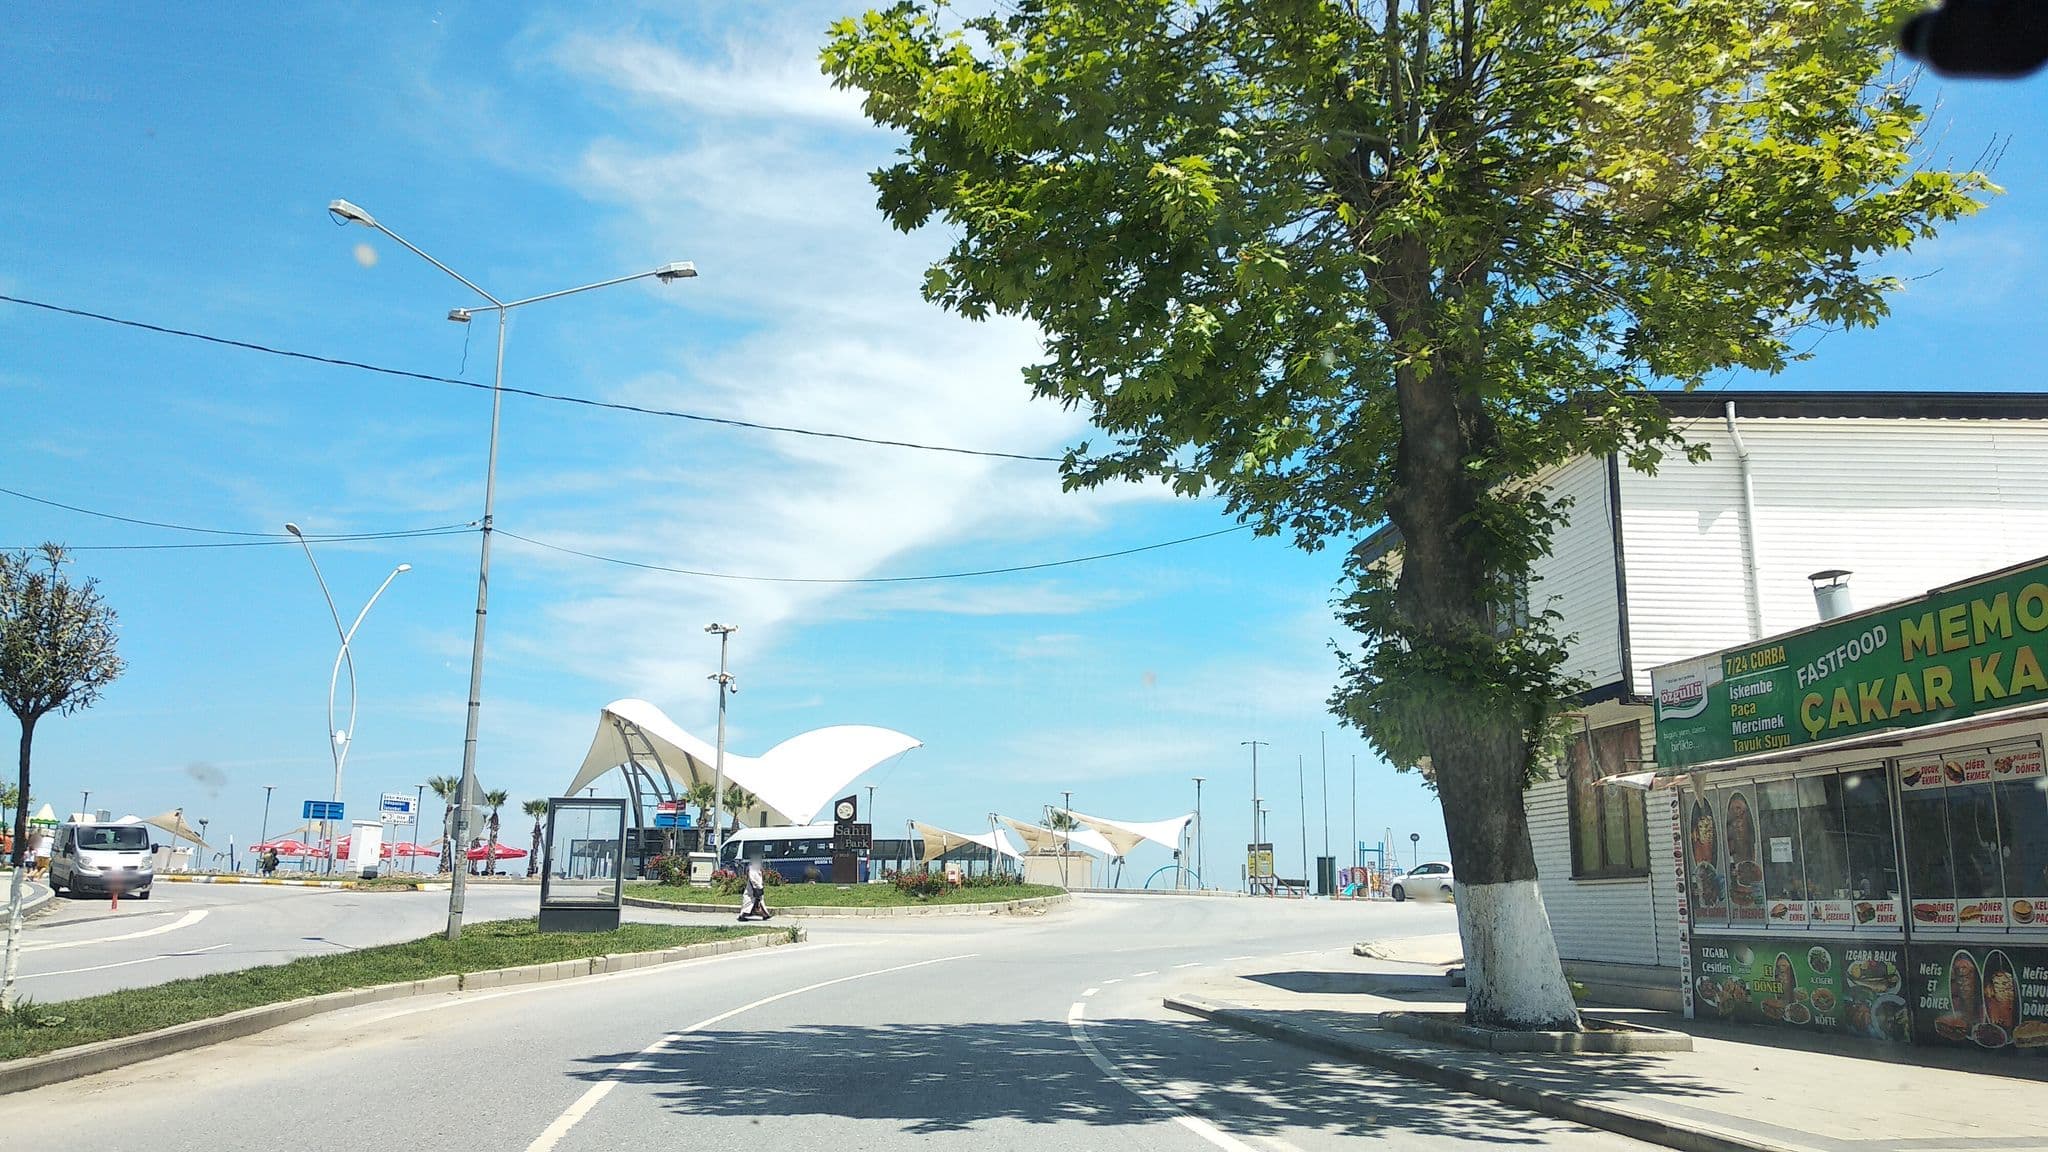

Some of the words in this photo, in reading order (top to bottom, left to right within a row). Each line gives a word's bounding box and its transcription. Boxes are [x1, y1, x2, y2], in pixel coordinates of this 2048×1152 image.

[1726, 656, 1748, 675] 7/24
[1750, 645, 1787, 670] ÇORBA
[1796, 625, 1888, 690] FASTFOOD
[1661, 681, 1703, 706] özgüllü
[1729, 680, 1773, 700] İşkembe
[1731, 702, 1756, 717] Paça
[1801, 666, 1956, 740] ÇAKAR
[1732, 714, 1784, 735] Mercimek
[1733, 736, 1762, 753] Tavuk
[1765, 734, 1790, 749] Suyu
[1922, 775, 1942, 786] EKMEK
[1966, 770, 1991, 781] EKMEK
[835, 825, 869, 836] Sahil
[846, 839, 869, 848] Park
[1877, 914, 1897, 923] EKMEK
[1702, 947, 1729, 959] IZGARA
[1845, 949, 1872, 961] IZGARA
[1874, 950, 1897, 963] BALIK
[1920, 962, 1942, 976] Nefis
[2023, 966, 2048, 980] Nefis
[1753, 977, 1784, 994] DÖNER
[1927, 980, 1938, 992] ET
[2021, 983, 2048, 998] TAVU
[1920, 994, 1949, 1010] DÖNER
